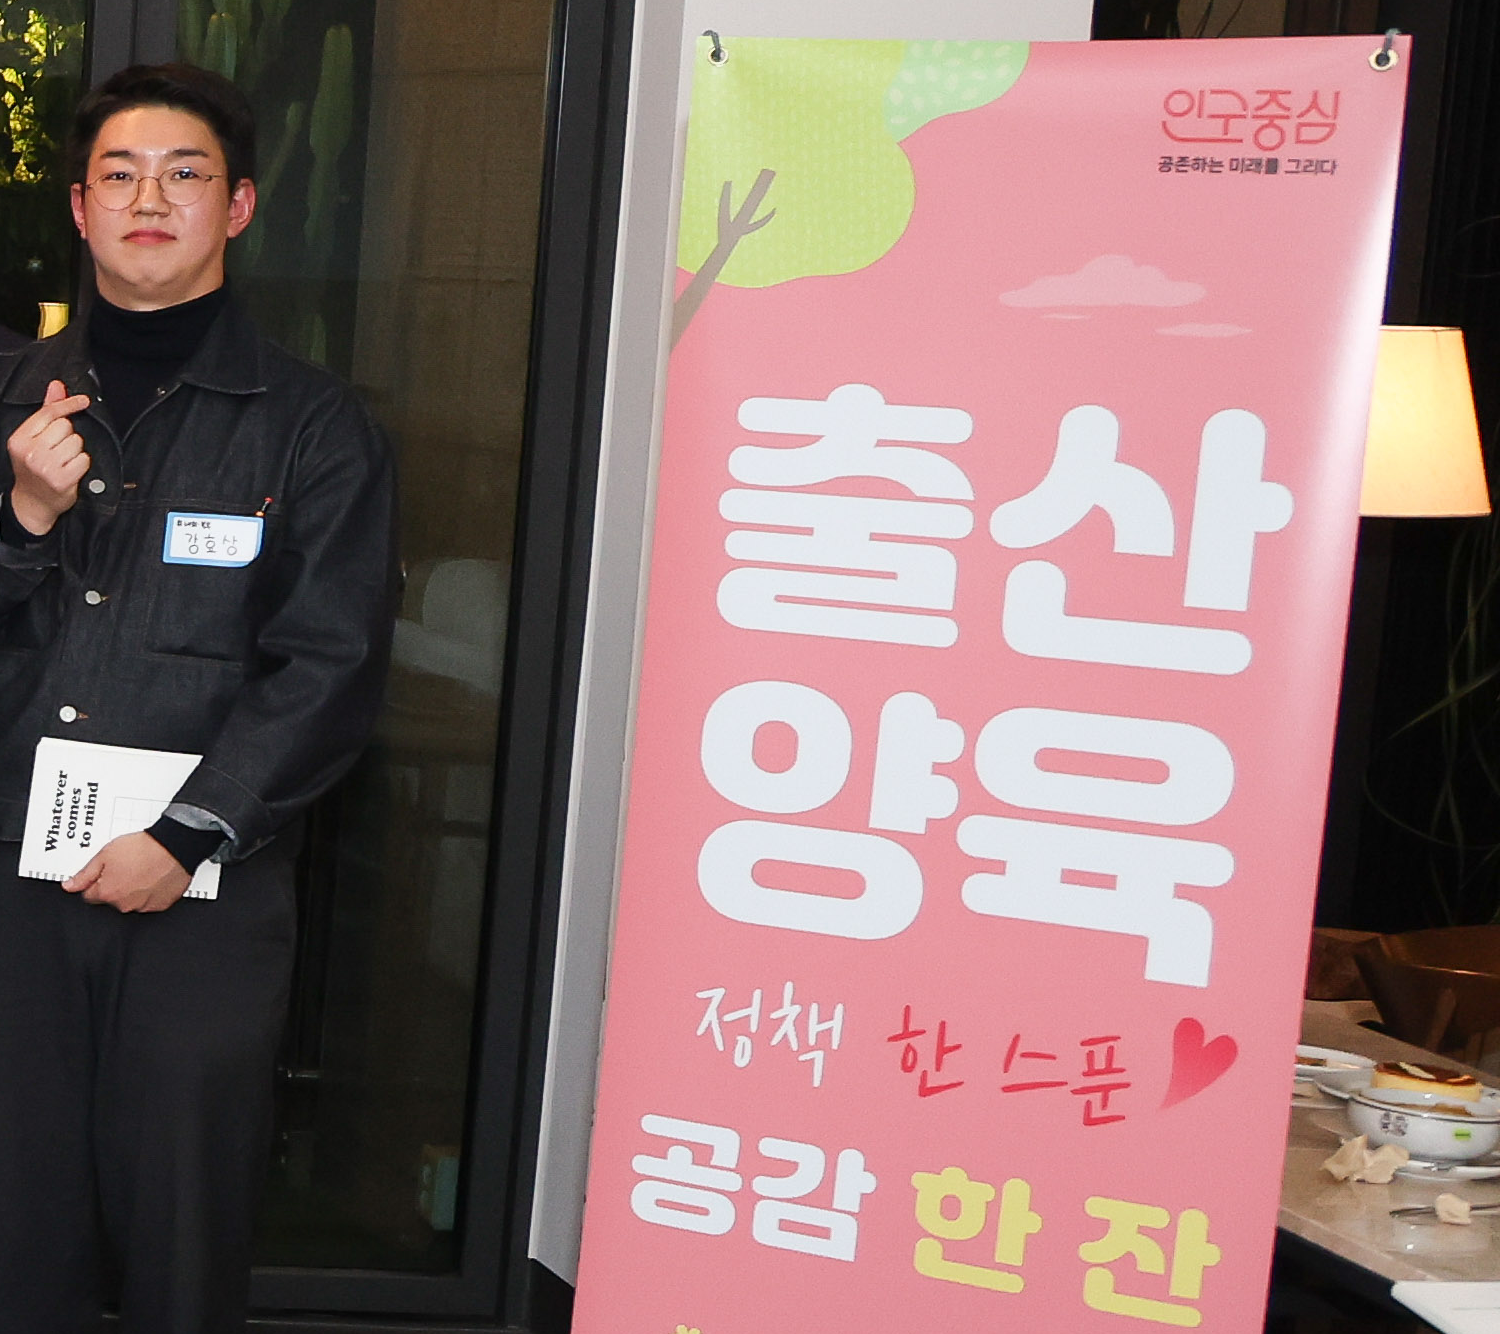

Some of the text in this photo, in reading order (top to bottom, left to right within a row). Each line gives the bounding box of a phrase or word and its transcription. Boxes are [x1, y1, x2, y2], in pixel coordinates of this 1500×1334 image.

[1161, 89, 1341, 151] 인구중심
[1158, 156, 1340, 175] 공존하는 미래를 그리다
[716, 383, 1295, 675] 출산
[45, 770, 68, 852] Whatever
[66, 788, 82, 840] comes
[80, 782, 99, 848] to mind
[697, 680, 1235, 988] 양육
[695, 981, 1132, 1127] 정책 한 스푼
[630, 1114, 1221, 1328] 공감 한 잔
